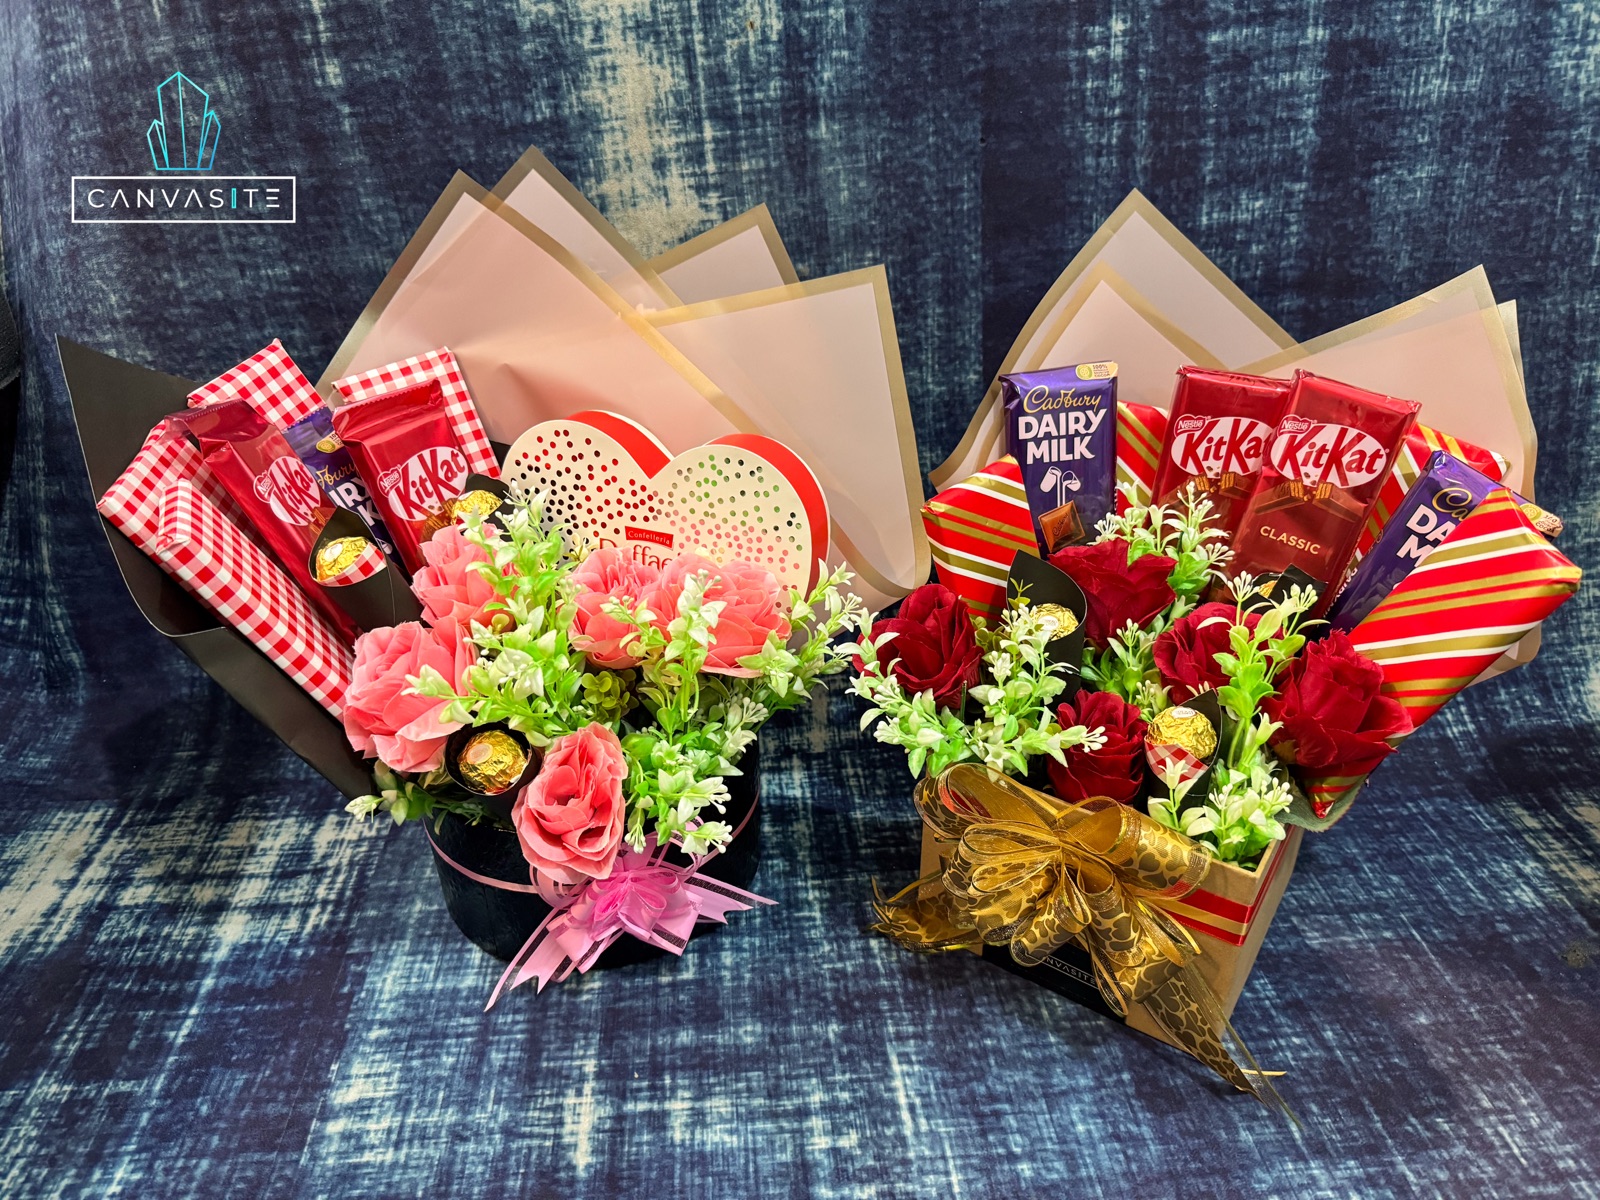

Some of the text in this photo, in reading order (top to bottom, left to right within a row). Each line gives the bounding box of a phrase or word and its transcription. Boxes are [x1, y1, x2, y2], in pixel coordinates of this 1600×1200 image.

[1023, 385, 1102, 413] Cadbury
[1018, 408, 1108, 440] DAIRY
[1026, 435, 1095, 465] MILK
[1277, 424, 1384, 487] KitKat
[269, 457, 320, 524] KitKat
[394, 448, 465, 520] KitKat
[1259, 525, 1321, 555] CLASSIC
[1046, 955, 1096, 985] NVASITE
